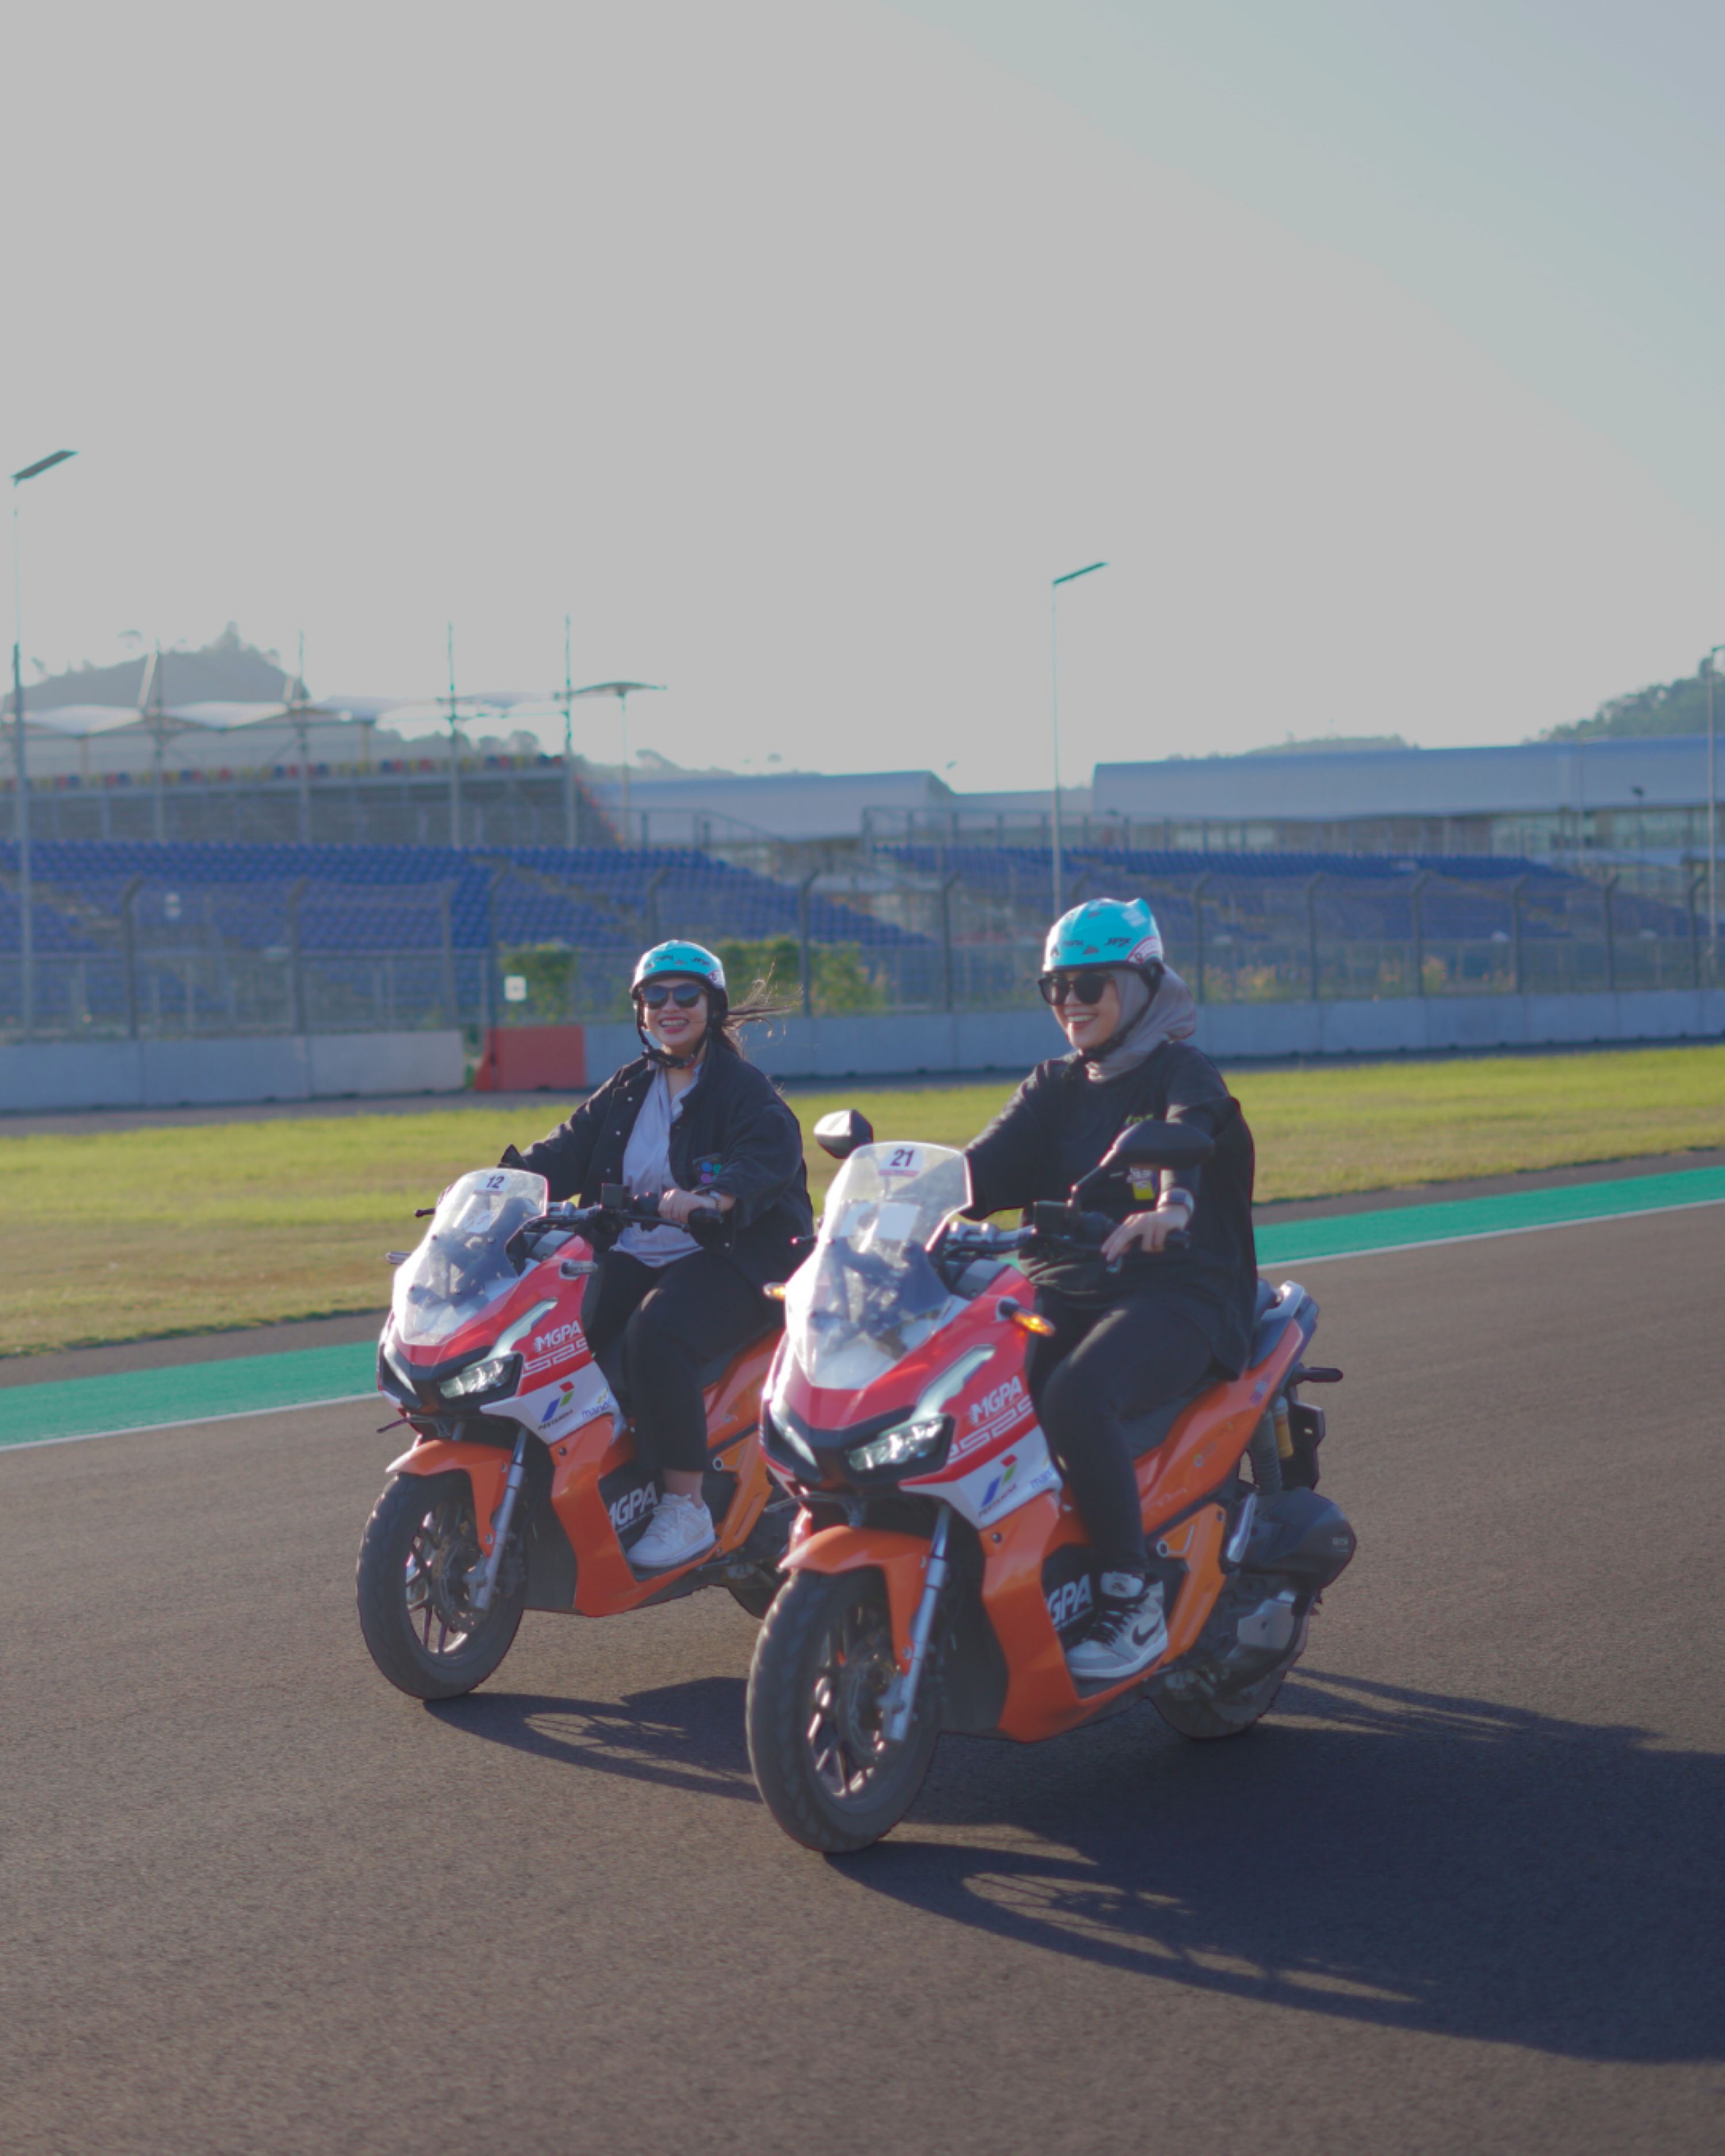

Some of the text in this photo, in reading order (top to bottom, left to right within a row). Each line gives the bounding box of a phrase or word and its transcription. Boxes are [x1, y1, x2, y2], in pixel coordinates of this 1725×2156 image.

[890, 1149, 915, 1167] 21
[486, 1175, 505, 1188] 12
[534, 1320, 582, 1352] MGPA
[969, 1376, 1022, 1425] MGPA
[1045, 1573, 1092, 1625] GPA
